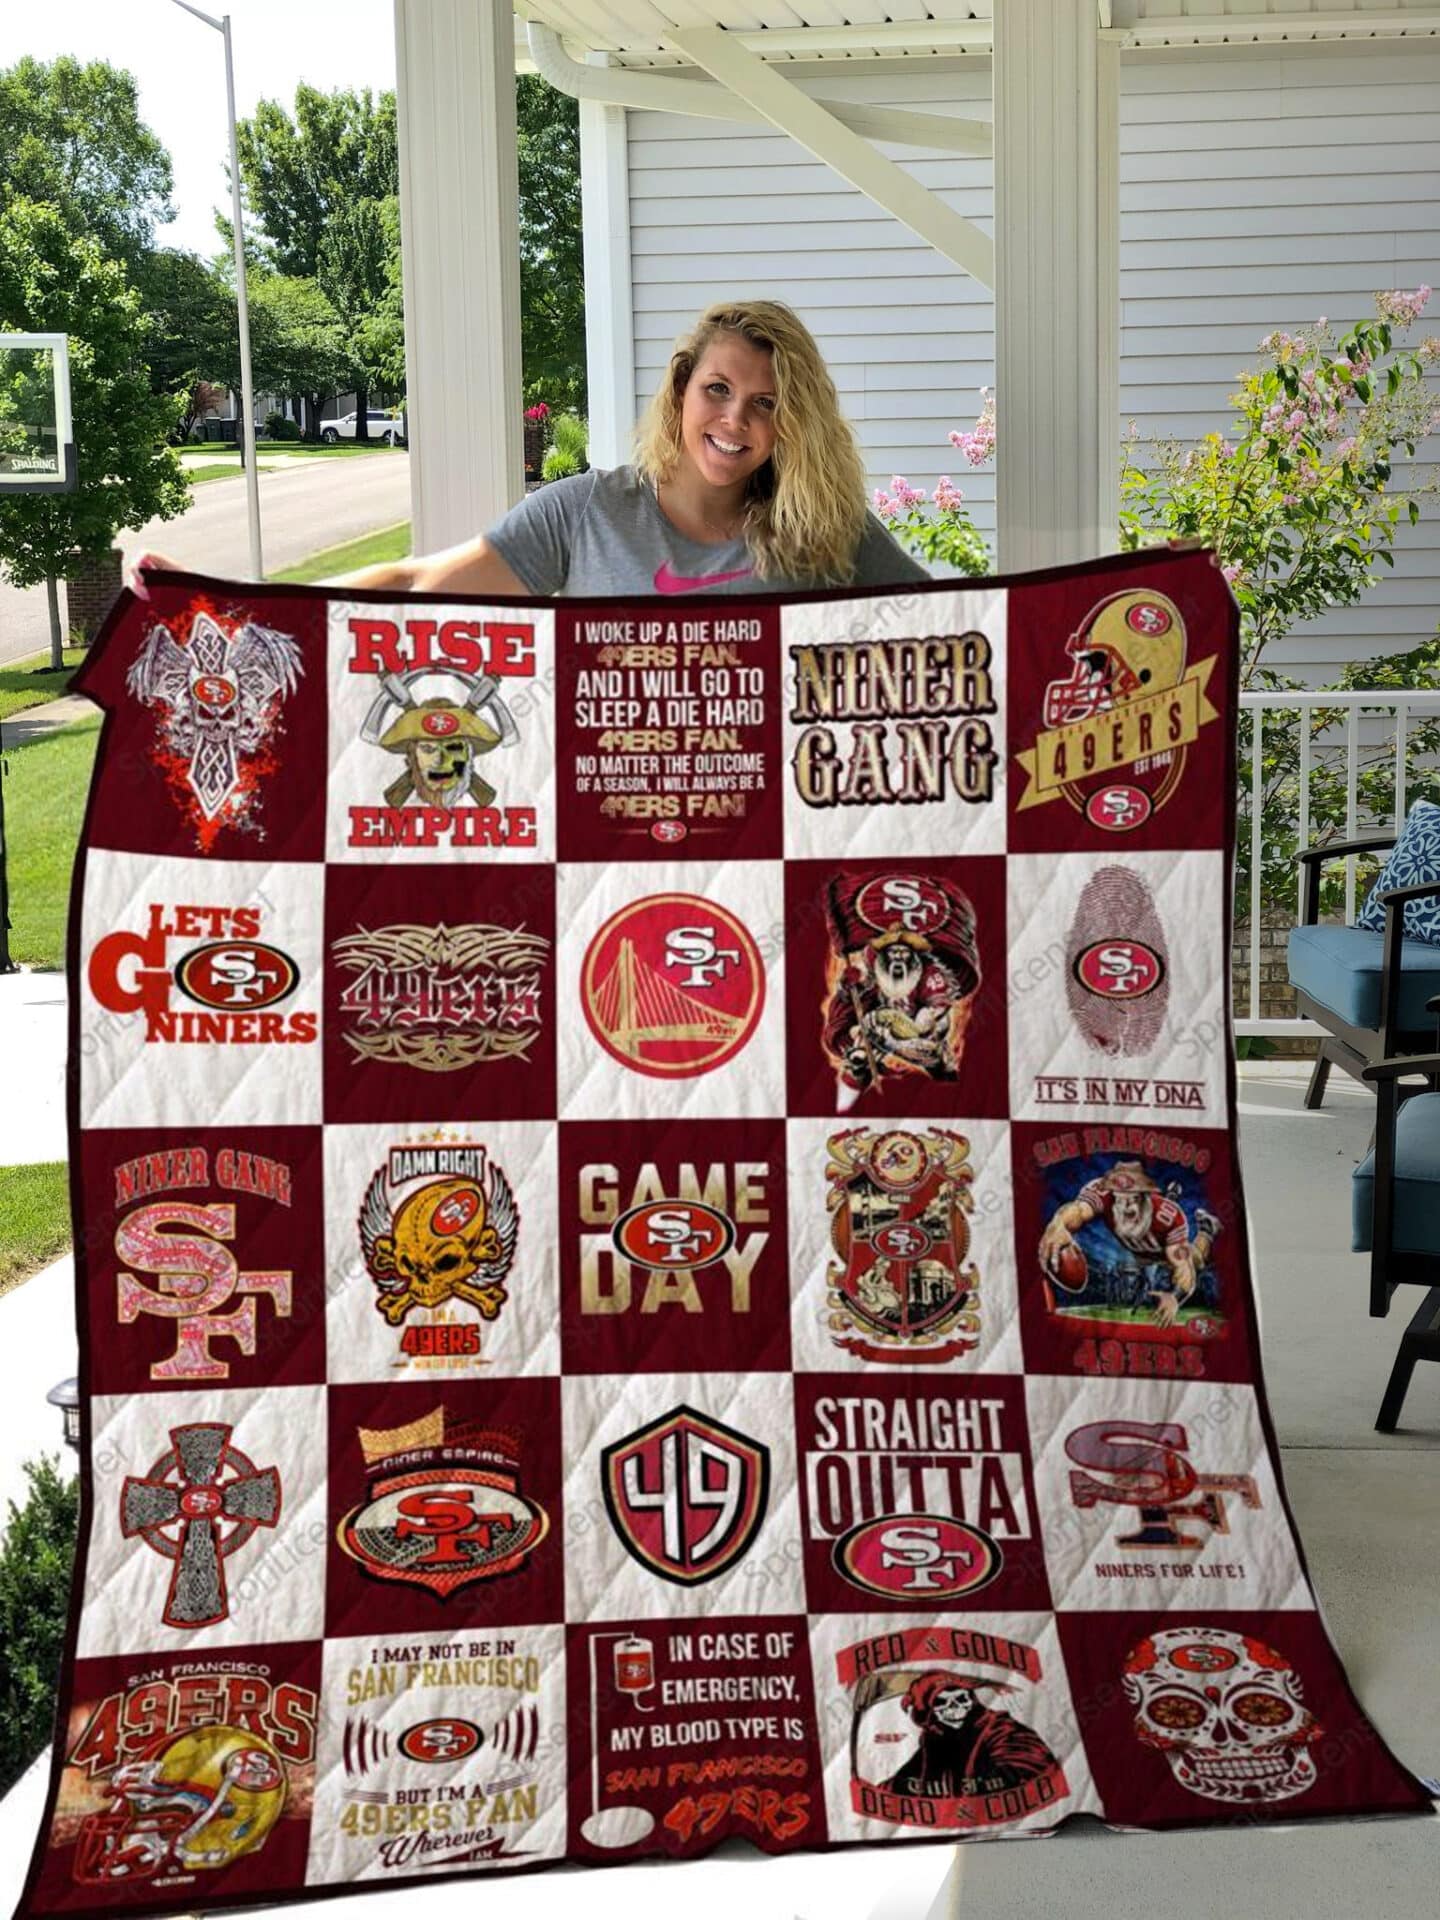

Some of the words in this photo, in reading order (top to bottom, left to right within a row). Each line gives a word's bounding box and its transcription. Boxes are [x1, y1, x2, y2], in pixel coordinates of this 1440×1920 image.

[11, 457, 57, 470] SPALDING
[348, 617, 536, 677] RISE
[575, 622, 580, 643] I
[585, 622, 634, 643] WOKE
[639, 622, 662, 643] UP
[666, 622, 678, 643] A
[682, 621, 709, 643] DIE
[714, 620, 762, 641] HARD
[576, 670, 623, 698] AND
[629, 670, 635, 698] I
[642, 670, 695, 698] WILL
[700, 668, 729, 696] GO
[736, 668, 764, 695] TO
[789, 630, 998, 723] NINER
[575, 700, 641, 727] SLEEP
[646, 700, 661, 727] A
[667, 700, 700, 726] DIE
[706, 699, 764, 725] HARD
[1053, 701, 1182, 779] 49ERS
[576, 756, 597, 775] NO
[600, 755, 660, 775] MATTER
[663, 754, 690, 774] THE
[694, 753, 765, 773] OUTCOME
[576, 777, 591, 792] OF
[593, 777, 602, 792] A
[663, 776, 690, 791] WILL
[692, 775, 737, 790] ALWAYS
[739, 775, 754, 789] BE
[756, 775, 765, 789] A
[793, 718, 998, 809] GANG
[348, 806, 537, 848] EMPIRE
[1101, 789, 1145, 826] SF
[149, 904, 261, 939] LETS
[210, 950, 278, 1003] SF
[664, 926, 740, 988] SF
[1098, 947, 1149, 992] SF
[145, 1012, 318, 1045] NINERS
[1037, 1079, 1079, 1101] IT'S
[1085, 1081, 1108, 1102] IN
[1115, 1082, 1149, 1103] MY
[1155, 1084, 1203, 1105] DNA
[114, 1147, 209, 1208] NINER
[216, 1148, 293, 1207] GANG
[392, 1150, 436, 1183] DAMN
[438, 1149, 484, 1181] RIGHT
[578, 1162, 770, 1224] GAME
[646, 1209, 713, 1263] SF
[115, 1201, 293, 1381] SF
[578, 1231, 770, 1316] DAY
[400, 1323, 481, 1357] 49ERS
[814, 1397, 1005, 1452] STRAIGHT
[622, 1429, 743, 1564] 49
[813, 1454, 1022, 1535] OUTTA
[395, 1489, 514, 1564] SF
[879, 1526, 972, 1589] SF
[1095, 1563, 1157, 1579] NINERS
[1160, 1563, 1195, 1579] FOR
[1199, 1563, 1247, 1579] LIFE!
[371, 1649, 378, 1664] I
[384, 1646, 422, 1664] MAY
[428, 1643, 463, 1660] NOT
[469, 1641, 491, 1658] BE
[496, 1640, 516, 1656] IN
[668, 1635, 693, 1663] IN
[699, 1633, 760, 1661] CASE
[765, 1632, 795, 1659] OF
[854, 1632, 905, 1677] RED
[950, 1629, 1028, 1673] GOLD
[127, 1669, 165, 1687] SAN
[171, 1661, 271, 1677] FRANCISCO
[347, 1663, 397, 1706] SAN
[406, 1655, 540, 1694] FRANCISCO
[661, 1675, 800, 1705] EMERGENCY,
[69, 1673, 318, 1779] 49ERS
[421, 1725, 468, 1758] SF
[610, 1727, 645, 1752] MY
[650, 1719, 721, 1748] BLOOD
[724, 1716, 780, 1740] TYPE
[783, 1718, 804, 1741] IS
[396, 1789, 432, 1806] BUT
[471, 1784, 483, 1799] A
[606, 1765, 662, 1793] SAN
[860, 1785, 937, 1825] DEAD
[983, 1775, 1056, 1821] COLD
[340, 1801, 452, 1839] 49ERS
[465, 1784, 539, 1828] FAN
[378, 1826, 497, 1869] Wherever
